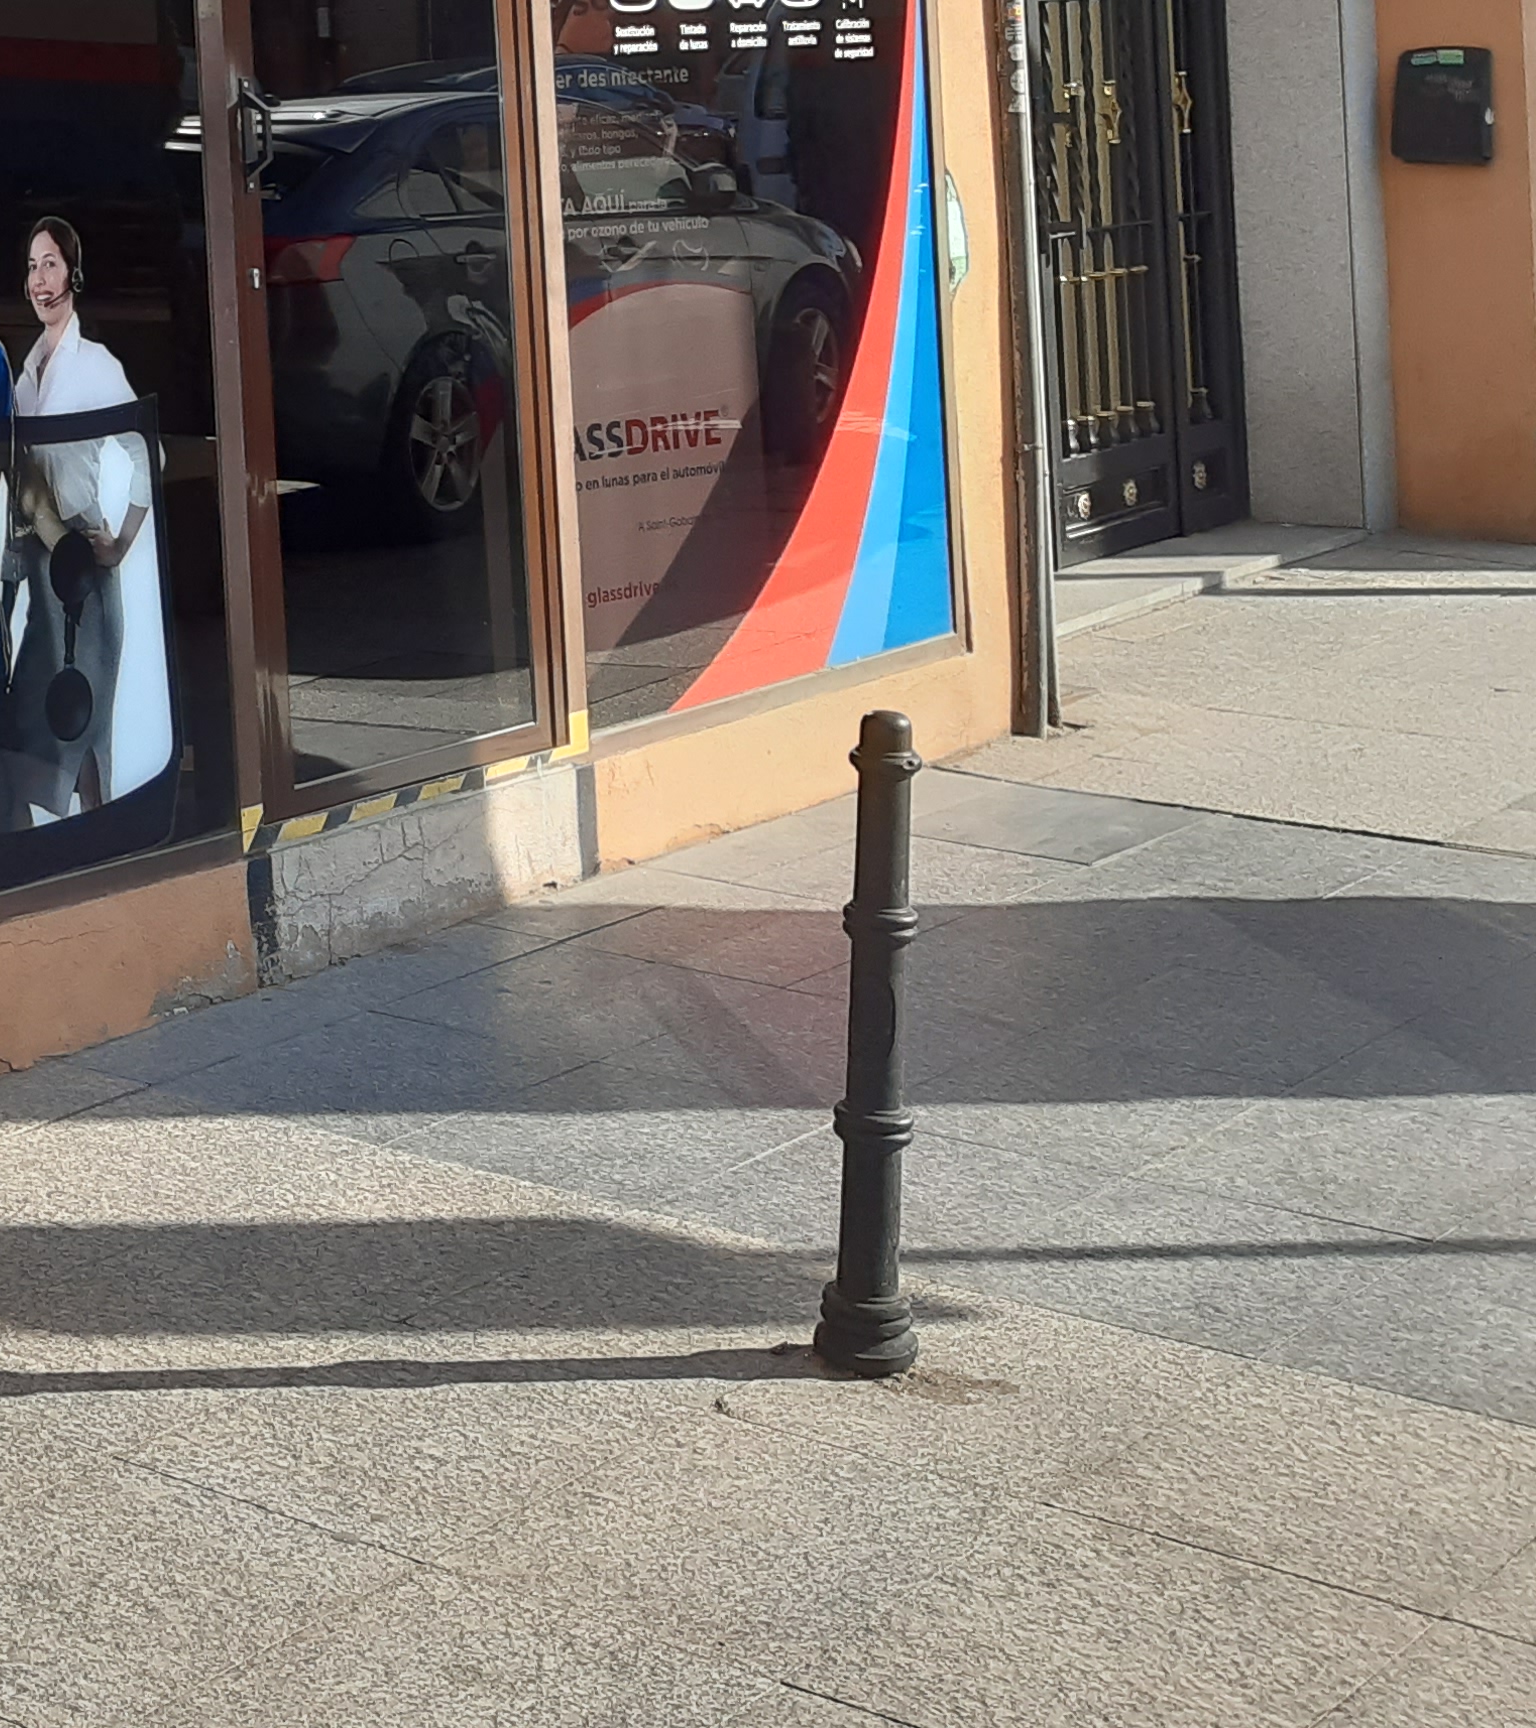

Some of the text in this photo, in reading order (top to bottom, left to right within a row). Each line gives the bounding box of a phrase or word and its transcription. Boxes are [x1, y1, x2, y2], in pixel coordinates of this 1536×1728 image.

[629, 220, 645, 235] de
[586, 479, 600, 491] en
[602, 474, 630, 488] lunas
[632, 472, 658, 486] para
[660, 467, 670, 481] el
